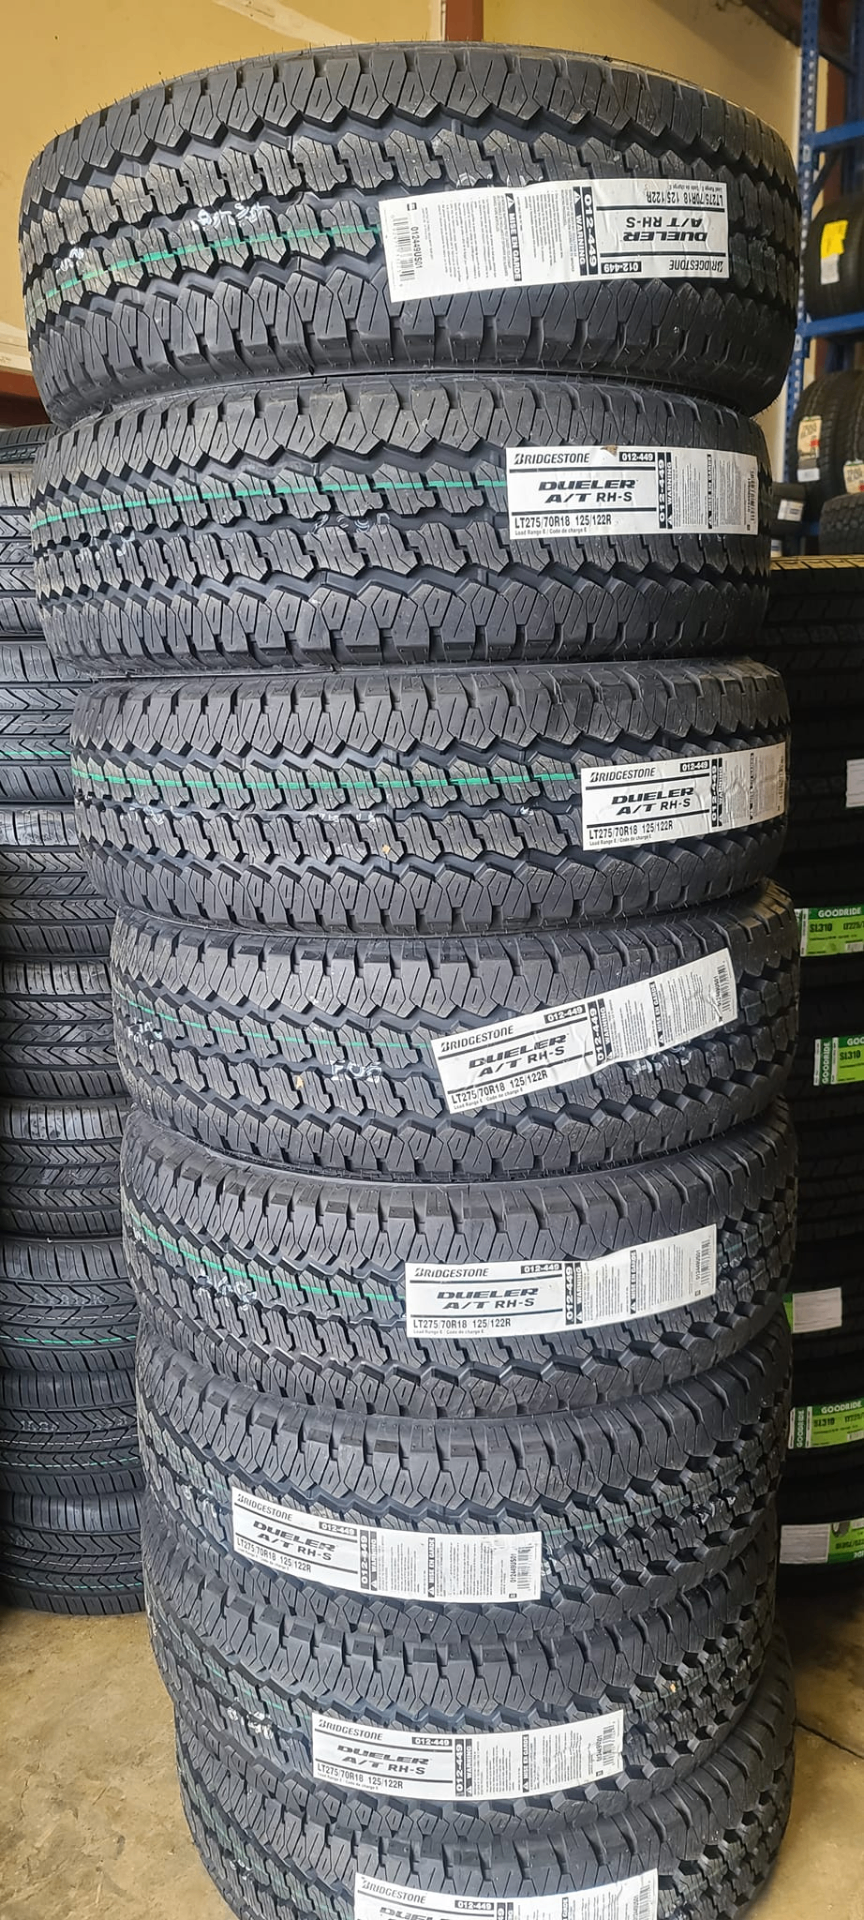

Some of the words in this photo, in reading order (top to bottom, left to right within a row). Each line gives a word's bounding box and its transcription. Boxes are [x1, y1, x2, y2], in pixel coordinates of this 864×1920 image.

[584, 194, 597, 267] 012-449
[626, 216, 662, 228] RH-S
[666, 217, 703, 228] A/T
[511, 236, 518, 248] EN
[576, 216, 586, 264] WARNING
[623, 231, 708, 242] DUELER
[513, 250, 521, 280] GARDE
[603, 262, 639, 272] 012-449
[669, 260, 723, 273] BRIDGESTONE
[514, 452, 590, 465] BRIDGESTONE
[621, 453, 654, 462] 012-449
[538, 479, 636, 490] DUELER
[544, 493, 592, 503] A/T
[596, 492, 632, 502] RH-S
[589, 768, 656, 782] BRIDGESTONE
[682, 762, 708, 772] 012-449
[611, 787, 694, 805] DUELER
[616, 804, 656, 816] A/T
[660, 799, 690, 811] RH-S
[818, 906, 861, 918] GOODRIDE
[650, 983, 658, 1005] GARDE
[654, 1006, 660, 1015] EN
[441, 1025, 514, 1052] BRIDGESTONE
[548, 1007, 583, 1021] 012-449
[590, 1008, 604, 1060] 012-449
[600, 1008, 610, 1044] WARNING
[468, 1035, 566, 1069] DUELER
[478, 1058, 522, 1078] A/T
[528, 1046, 565, 1064] RH-S
[822, 1042, 830, 1084] GOODRIDE
[415, 1268, 489, 1278] BRIDGESTONE
[524, 1264, 560, 1272] 012-449
[437, 1288, 538, 1299] DUELER
[566, 1266, 574, 1320] 012-449
[443, 1301, 490, 1310] A/T
[495, 1298, 534, 1309] RH-S
[822, 1400, 862, 1414] GOODRIDE
[237, 1494, 293, 1521] BRIDGESTONE
[322, 1523, 354, 1535] 012-449
[253, 1520, 336, 1552] DUELER
[258, 1533, 294, 1548] A/T
[298, 1546, 332, 1560] RH-S
[429, 1560, 434, 1568] EN
[318, 1720, 383, 1740] BRIDGESTONE
[415, 1738, 450, 1746] 012-449
[338, 1745, 429, 1765] DUELER
[523, 1756, 528, 1764] EN
[342, 1756, 383, 1768] A/T
[388, 1764, 426, 1775] RH-S
[456, 1744, 464, 1792] 012-449
[362, 1880, 426, 1903] BRIDGESTONE
[458, 1902, 491, 1910] 012-449
